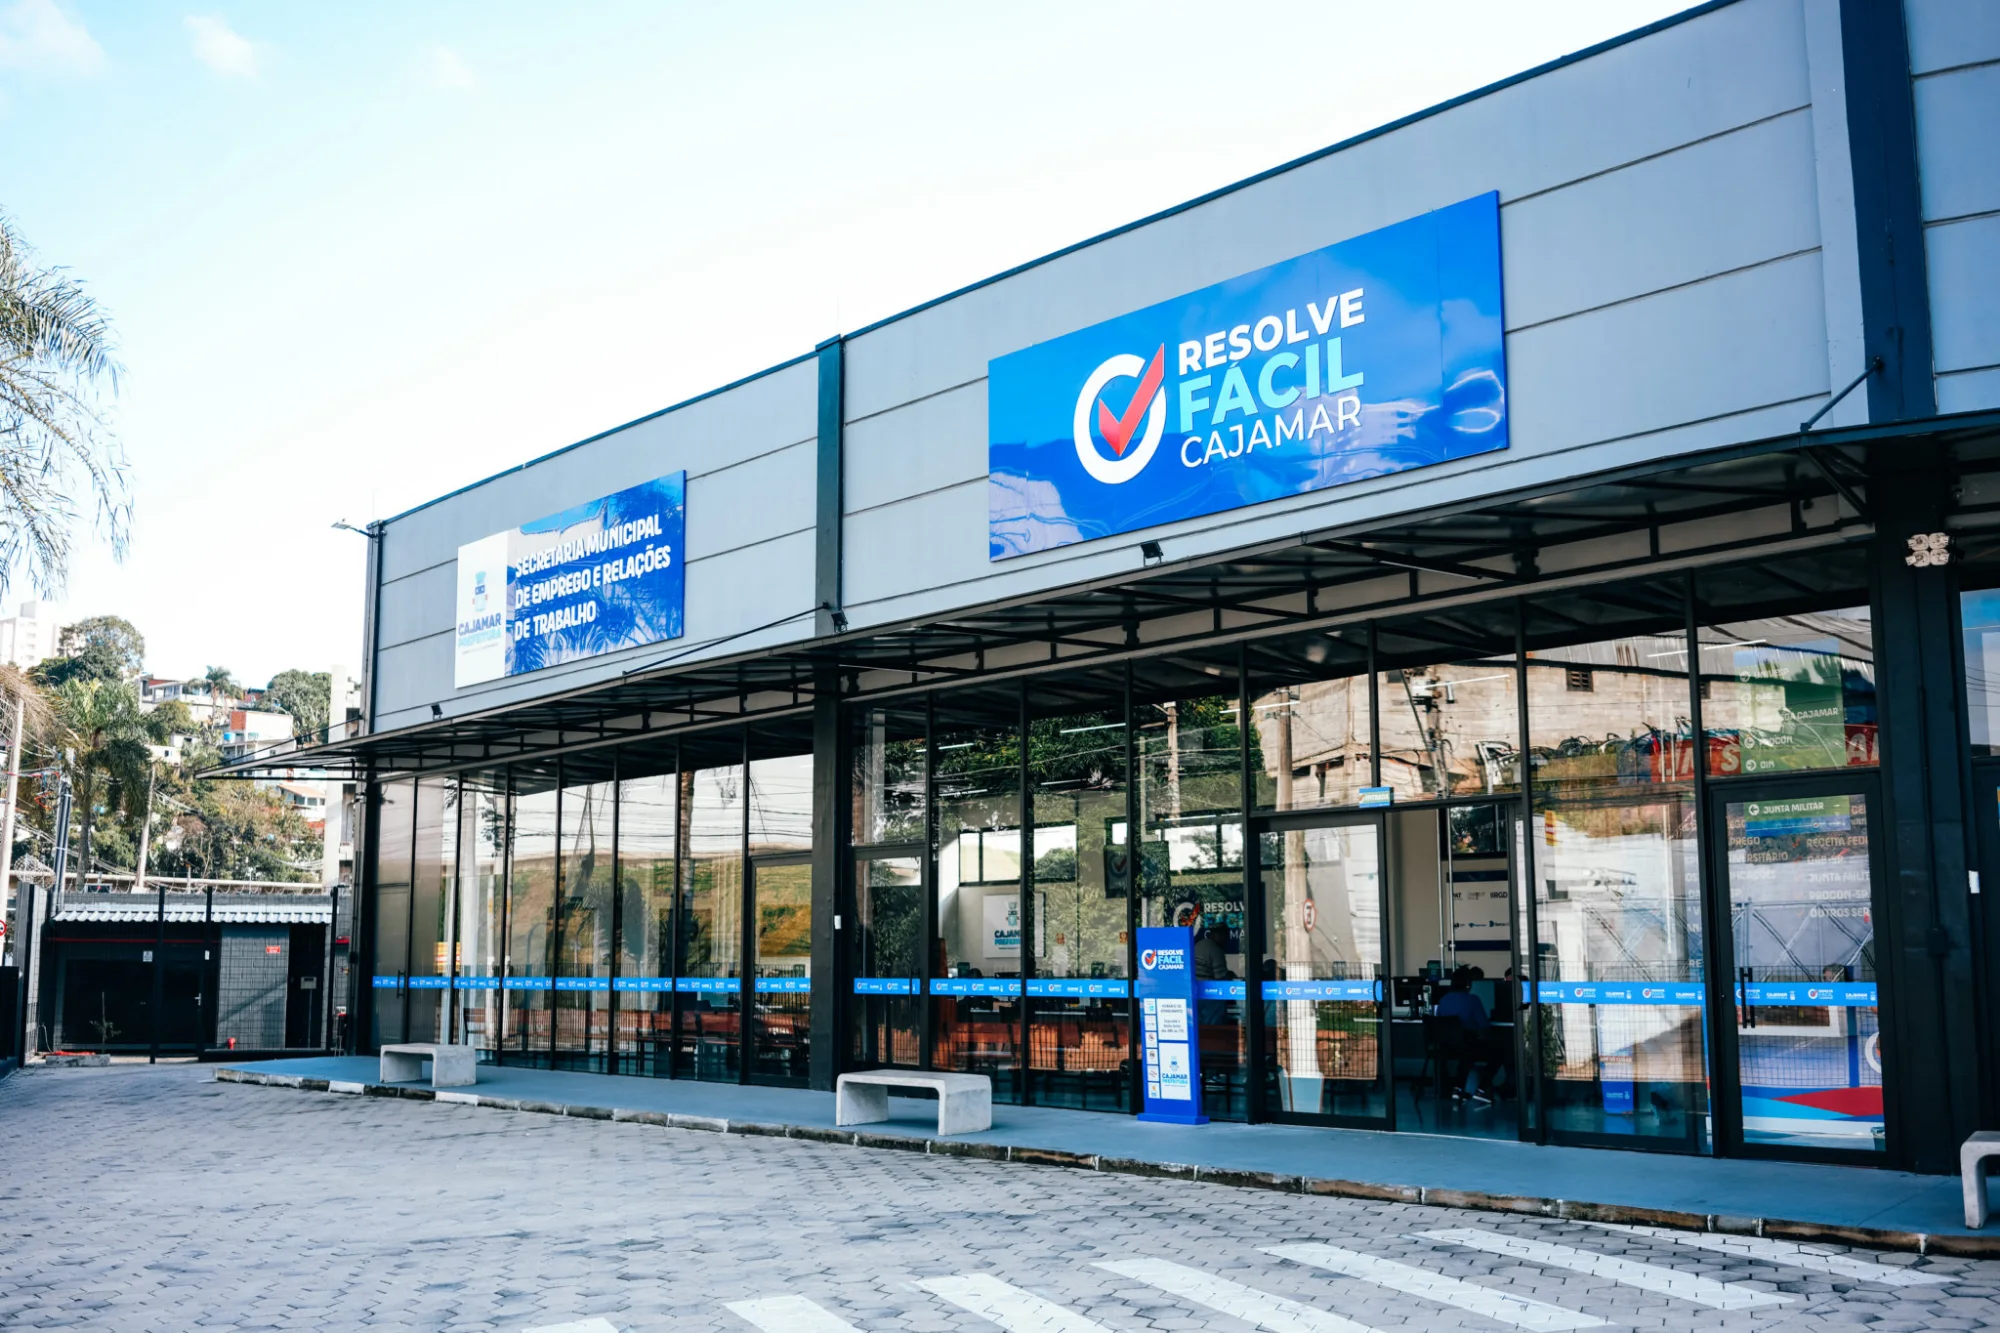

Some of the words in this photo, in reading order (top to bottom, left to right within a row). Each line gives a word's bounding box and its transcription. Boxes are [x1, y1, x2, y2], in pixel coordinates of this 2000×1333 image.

[1178, 287, 1365, 376] RESOLVE
[1179, 336, 1364, 433] FÁCIL
[1180, 395, 1362, 468] CAJAMAR
[515, 538, 585, 578] SECRETARIA
[585, 514, 662, 556] MUNICIPAL
[515, 586, 531, 609] DE
[532, 568, 591, 604] EMPREGO
[593, 565, 601, 587] E
[603, 544, 671, 585] RELAÇÕES
[458, 612, 501, 636] CAJAMAR
[514, 618, 531, 641] DE
[533, 600, 597, 636] TRABALHO
[1797, 707, 1838, 720] CAJAMAR
[1763, 803, 1790, 814] JUNTA
[1791, 801, 1824, 812] MILITAR
[1806, 838, 1845, 848] RECEITA
[1203, 901, 1244, 912] RESOLV
[1810, 907, 1850, 918] OUTROS
[1851, 907, 1870, 917] SER
[1158, 955, 1184, 964] FÁCIL
